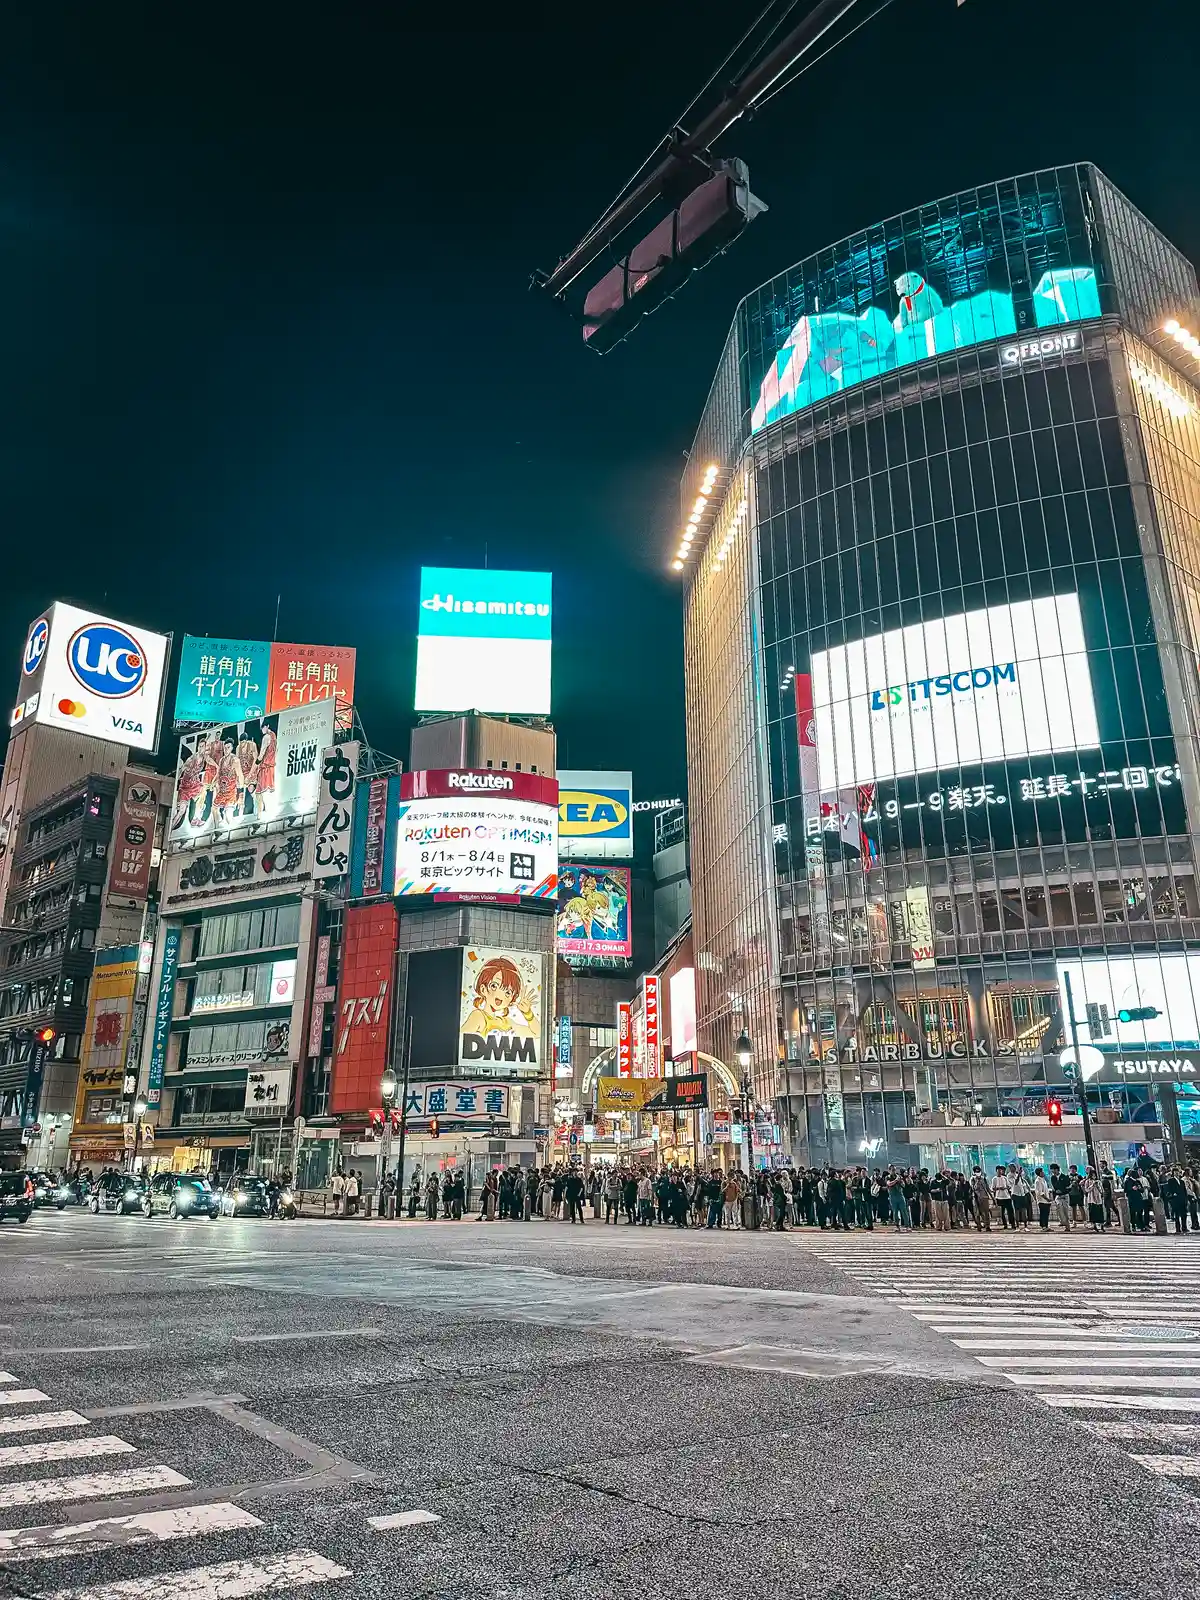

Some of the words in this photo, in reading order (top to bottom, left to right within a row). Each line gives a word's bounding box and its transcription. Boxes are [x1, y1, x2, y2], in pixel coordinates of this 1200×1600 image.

[200, 654, 252, 677] 龍角散
[288, 660, 338, 682] 龍角散
[190, 677, 260, 699] ダイレクト
[111, 715, 143, 734] VISA
[287, 745, 317, 764] SLAM
[286, 758, 316, 777] DUNK
[448, 772, 513, 791] Rakuten
[315, 747, 354, 873] もんじゃ
[404, 825, 471, 843] Rakuten
[458, 893, 480, 901] Rakuten
[157, 947, 176, 1041] サマーフルーツギフト
[646, 983, 657, 1037] カラオケ
[461, 1032, 537, 1063] DMM
[825, 1038, 1013, 1065] STARBUCKS
[1113, 1059, 1198, 1075] TSUTAYA
